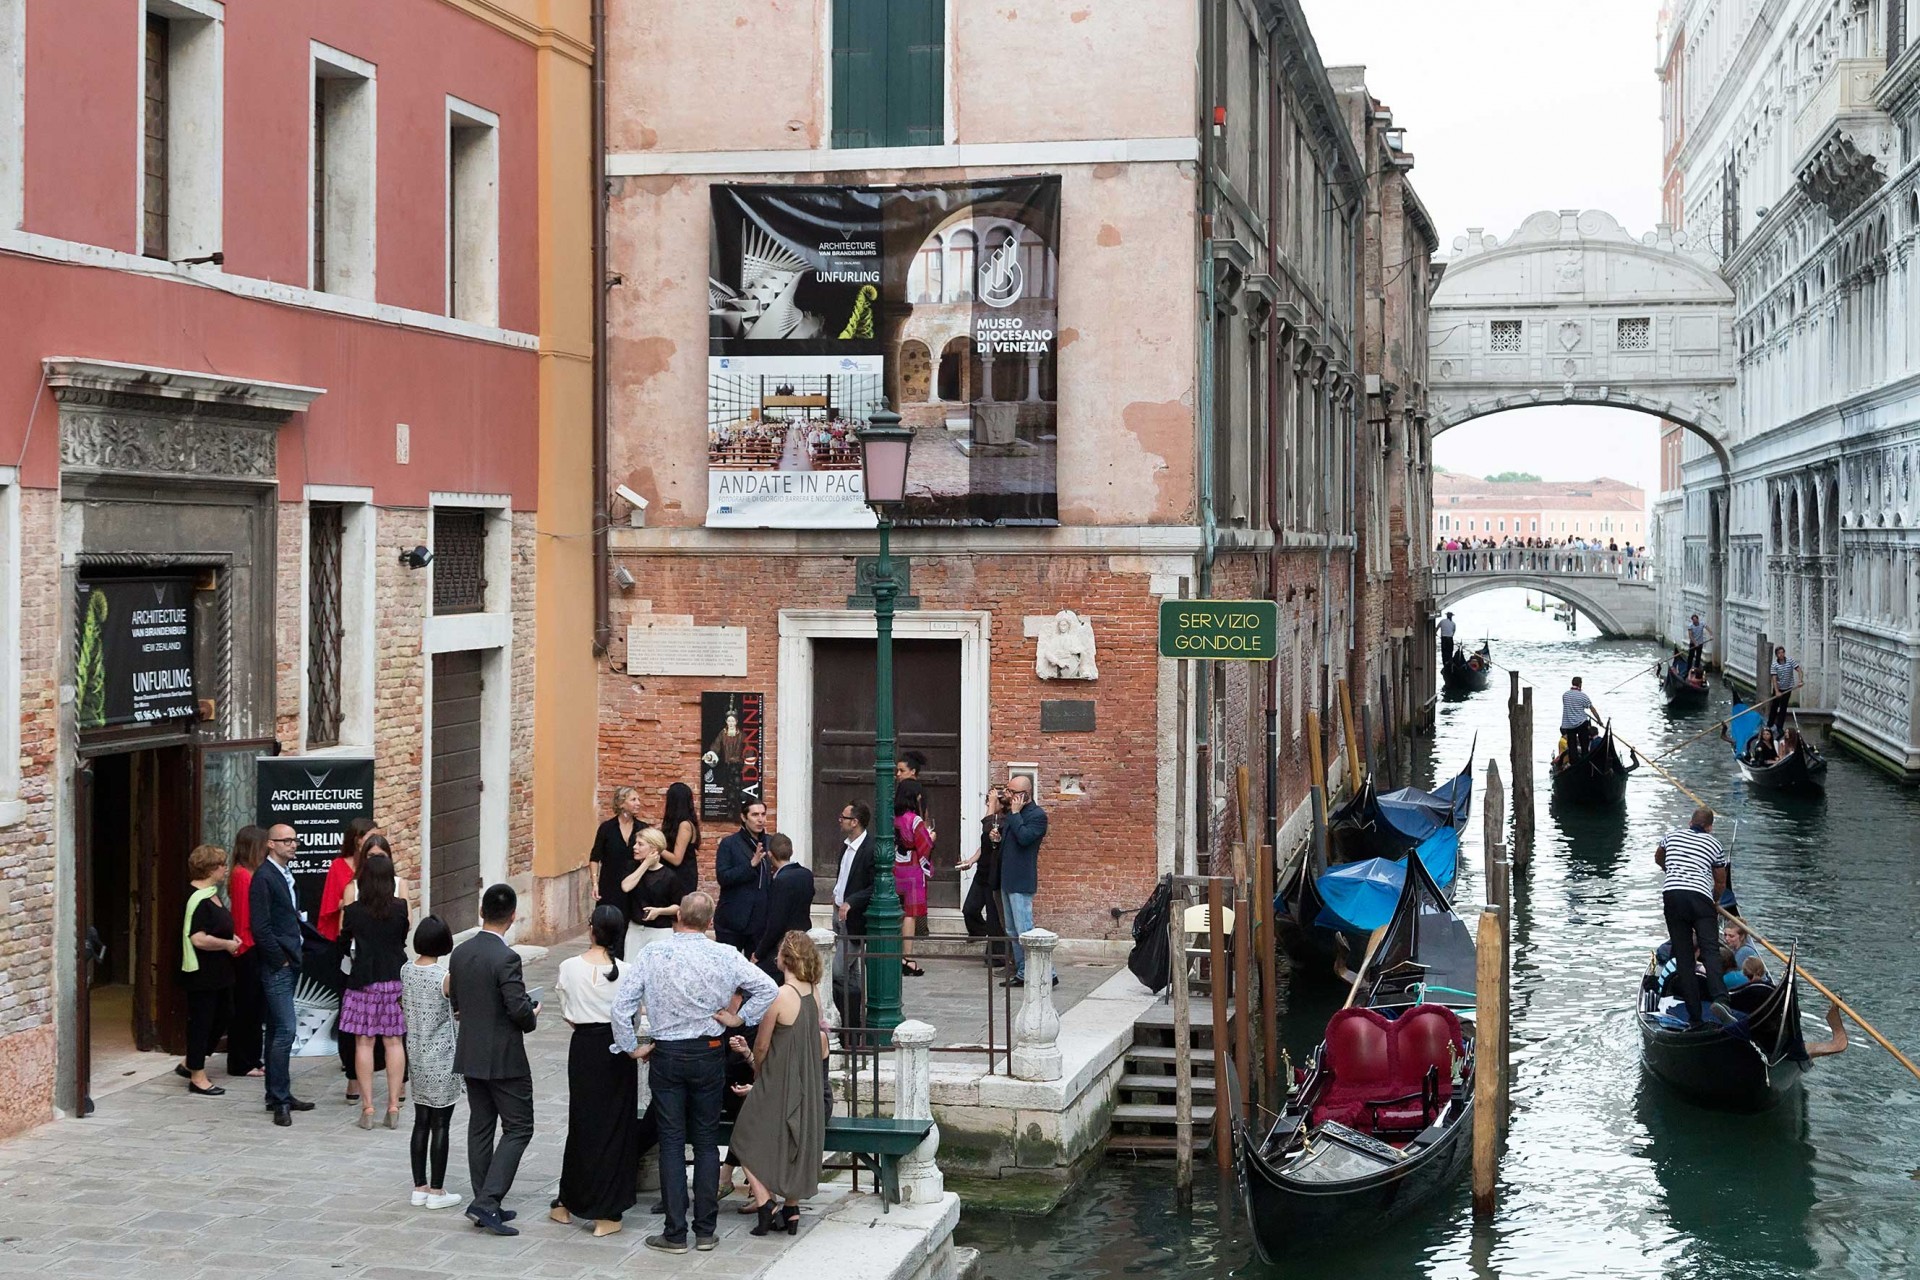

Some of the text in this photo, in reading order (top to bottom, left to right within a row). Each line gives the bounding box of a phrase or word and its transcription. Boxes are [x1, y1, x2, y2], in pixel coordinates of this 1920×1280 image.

[819, 241, 876, 250] ARCHITECTURE
[816, 271, 880, 283] UNFURLING
[977, 318, 1023, 329] MUSEO
[977, 329, 1053, 341] DIOCESANO
[977, 341, 1049, 353] DI VENEZIA
[719, 474, 864, 494] ANDATE IN PAC
[132, 609, 187, 625] ARCHITECTURE
[1179, 613, 1260, 629] SERVIZIO
[1175, 635, 1261, 651] GONDOLE
[133, 668, 192, 693] UNFURLING
[742, 695, 759, 804] ADONNE
[271, 789, 363, 800] ARCHITECTURE
[292, 802, 363, 811] BRANDENBURG
[296, 833, 344, 846] FURLIN
[288, 860, 310, 868] 06.14
[321, 860, 332, 868] 23
